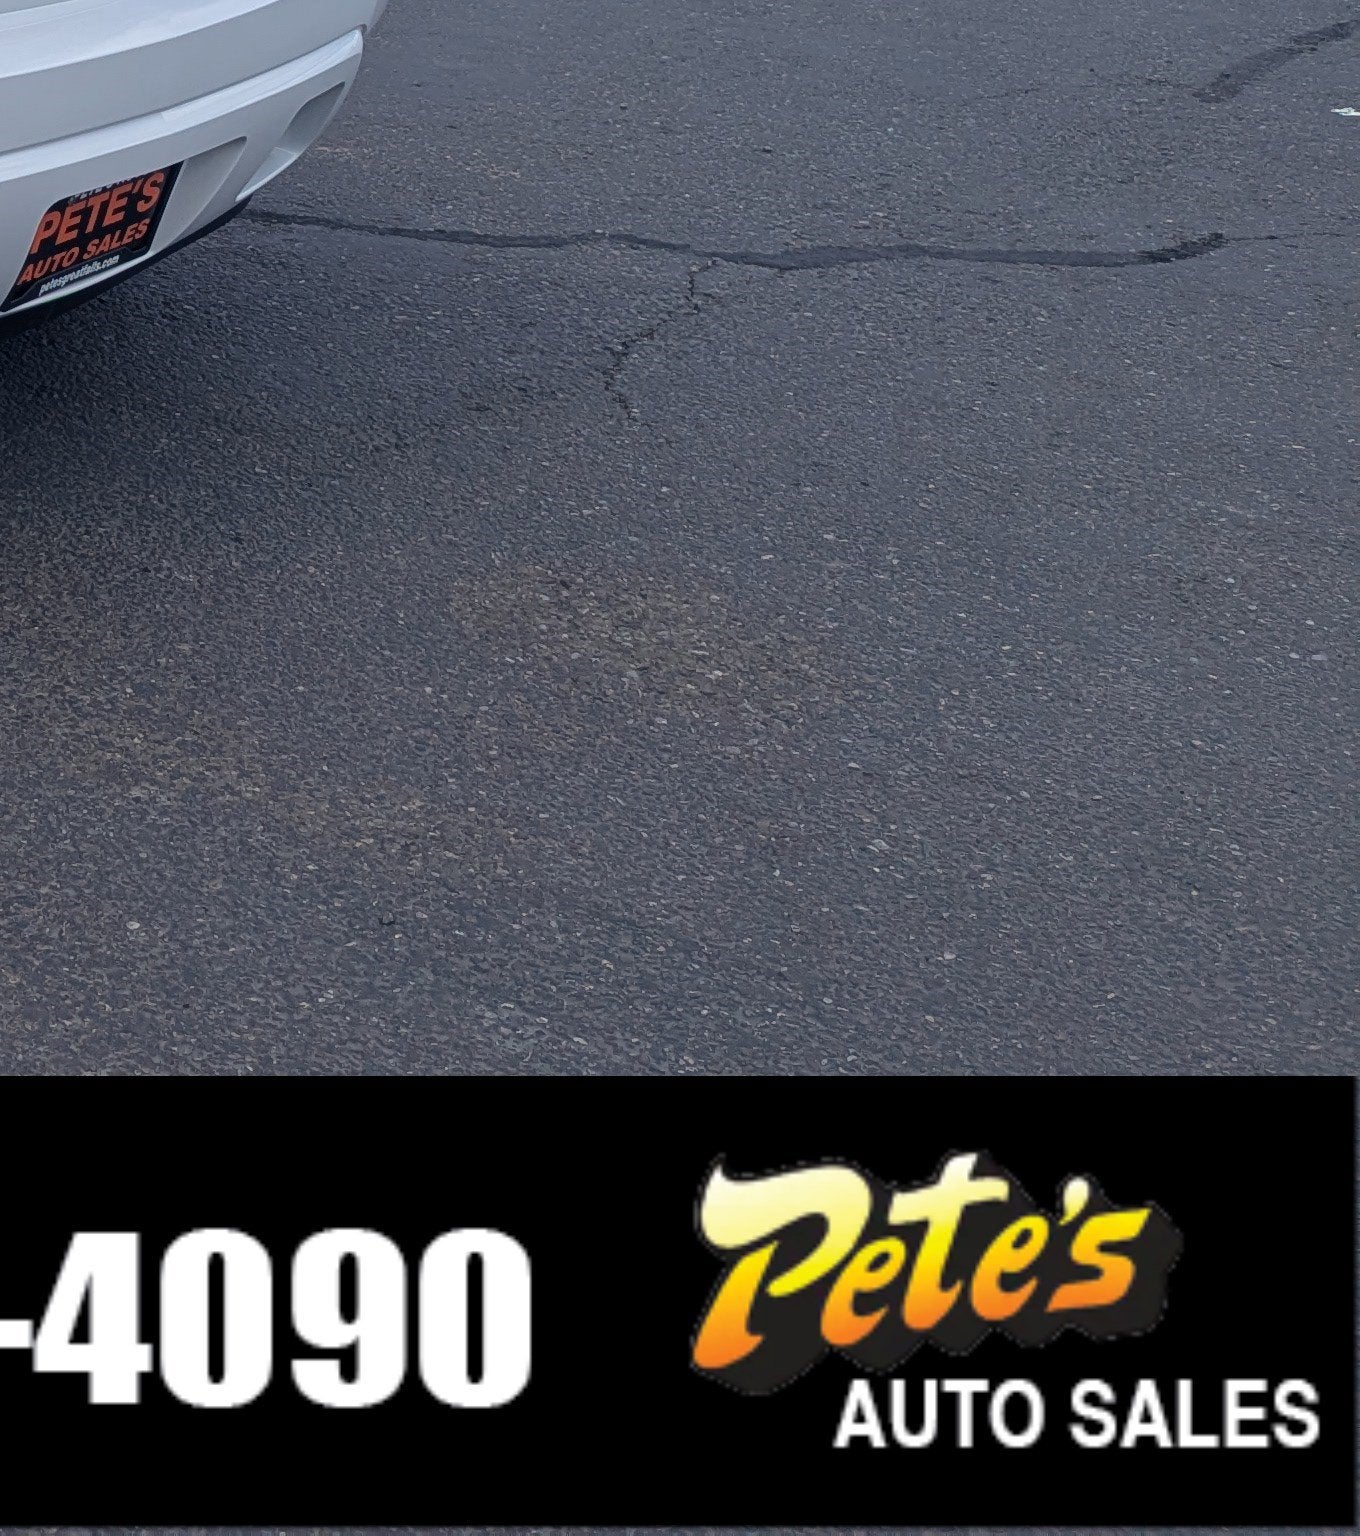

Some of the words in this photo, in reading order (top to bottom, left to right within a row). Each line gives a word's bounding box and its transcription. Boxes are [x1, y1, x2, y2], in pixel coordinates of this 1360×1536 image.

[30, 171, 165, 255] PETE'S
[17, 246, 80, 286] AUTO
[83, 217, 151, 261] SALES
